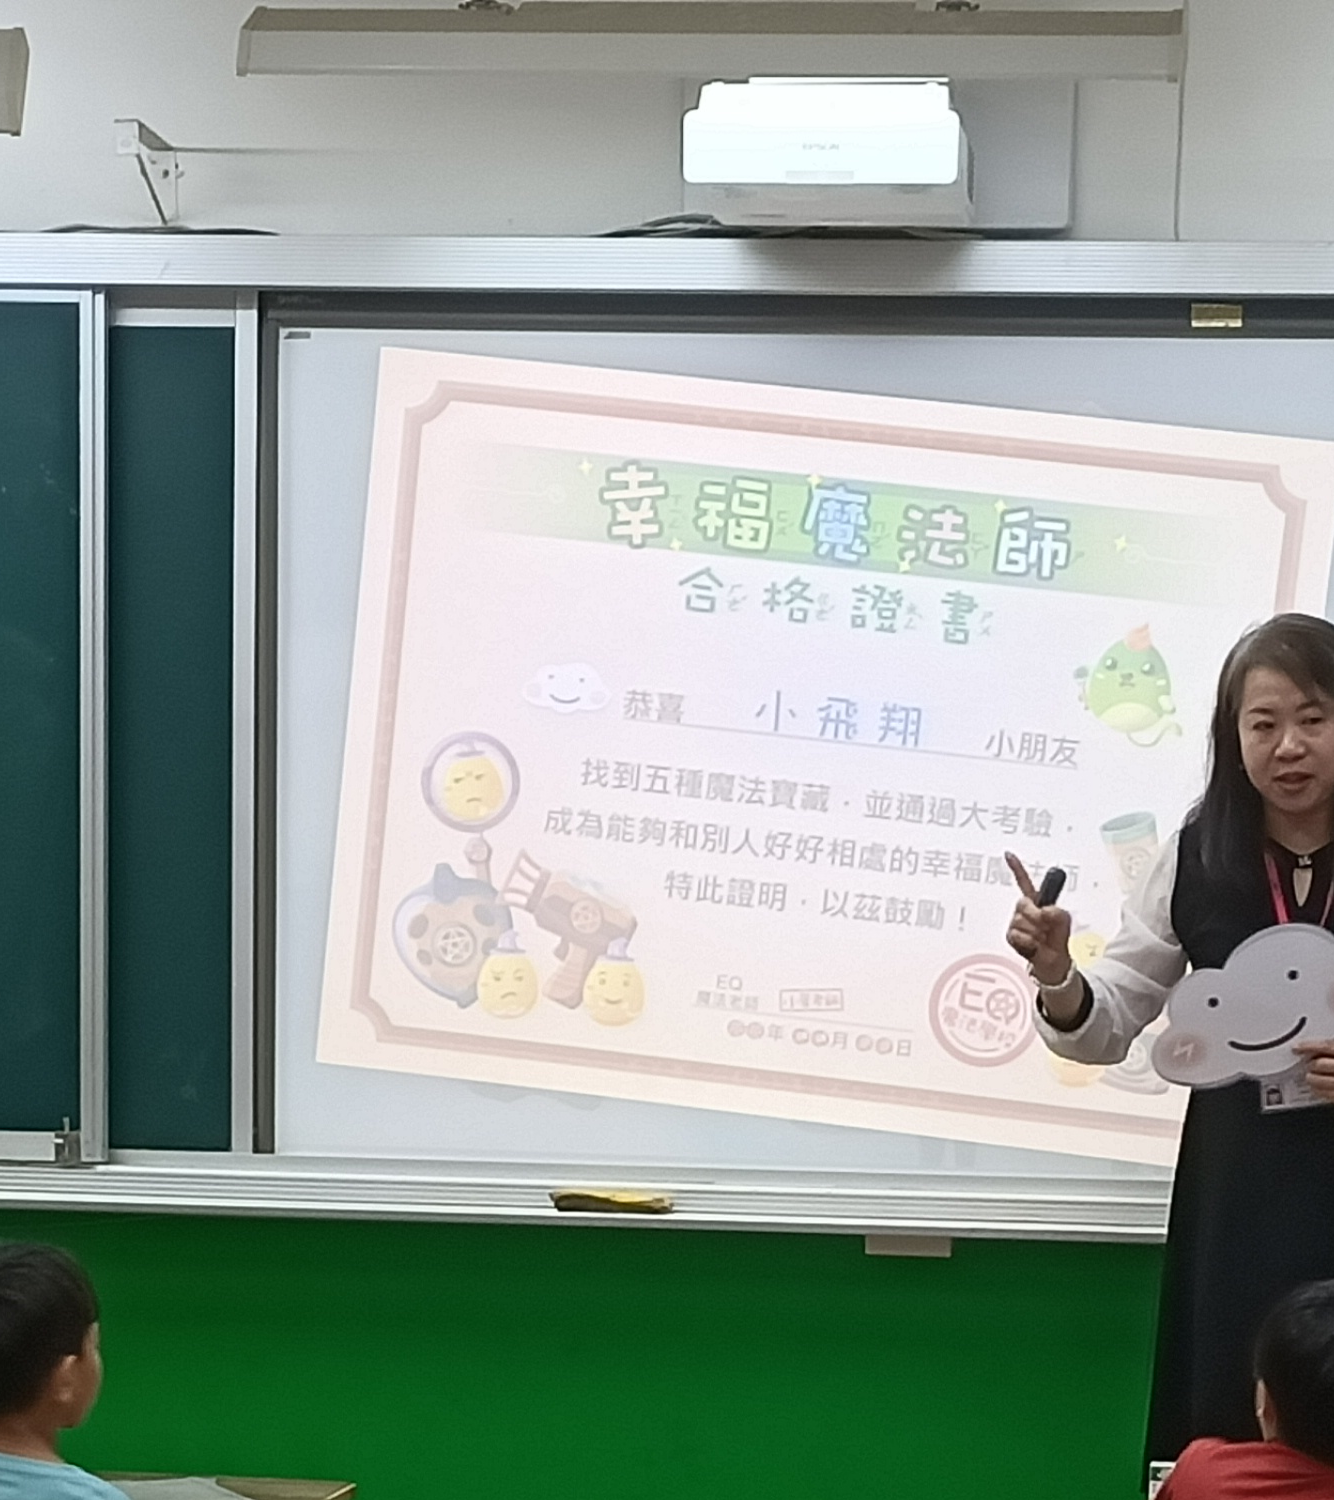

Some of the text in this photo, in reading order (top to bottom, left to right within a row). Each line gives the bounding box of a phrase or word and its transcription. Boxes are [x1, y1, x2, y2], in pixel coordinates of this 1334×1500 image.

[599, 460, 1071, 581] 幸福魔法師
[678, 566, 978, 646] 合格證書
[623, 689, 1080, 767] 恭喜 小飛翔 小朋友
